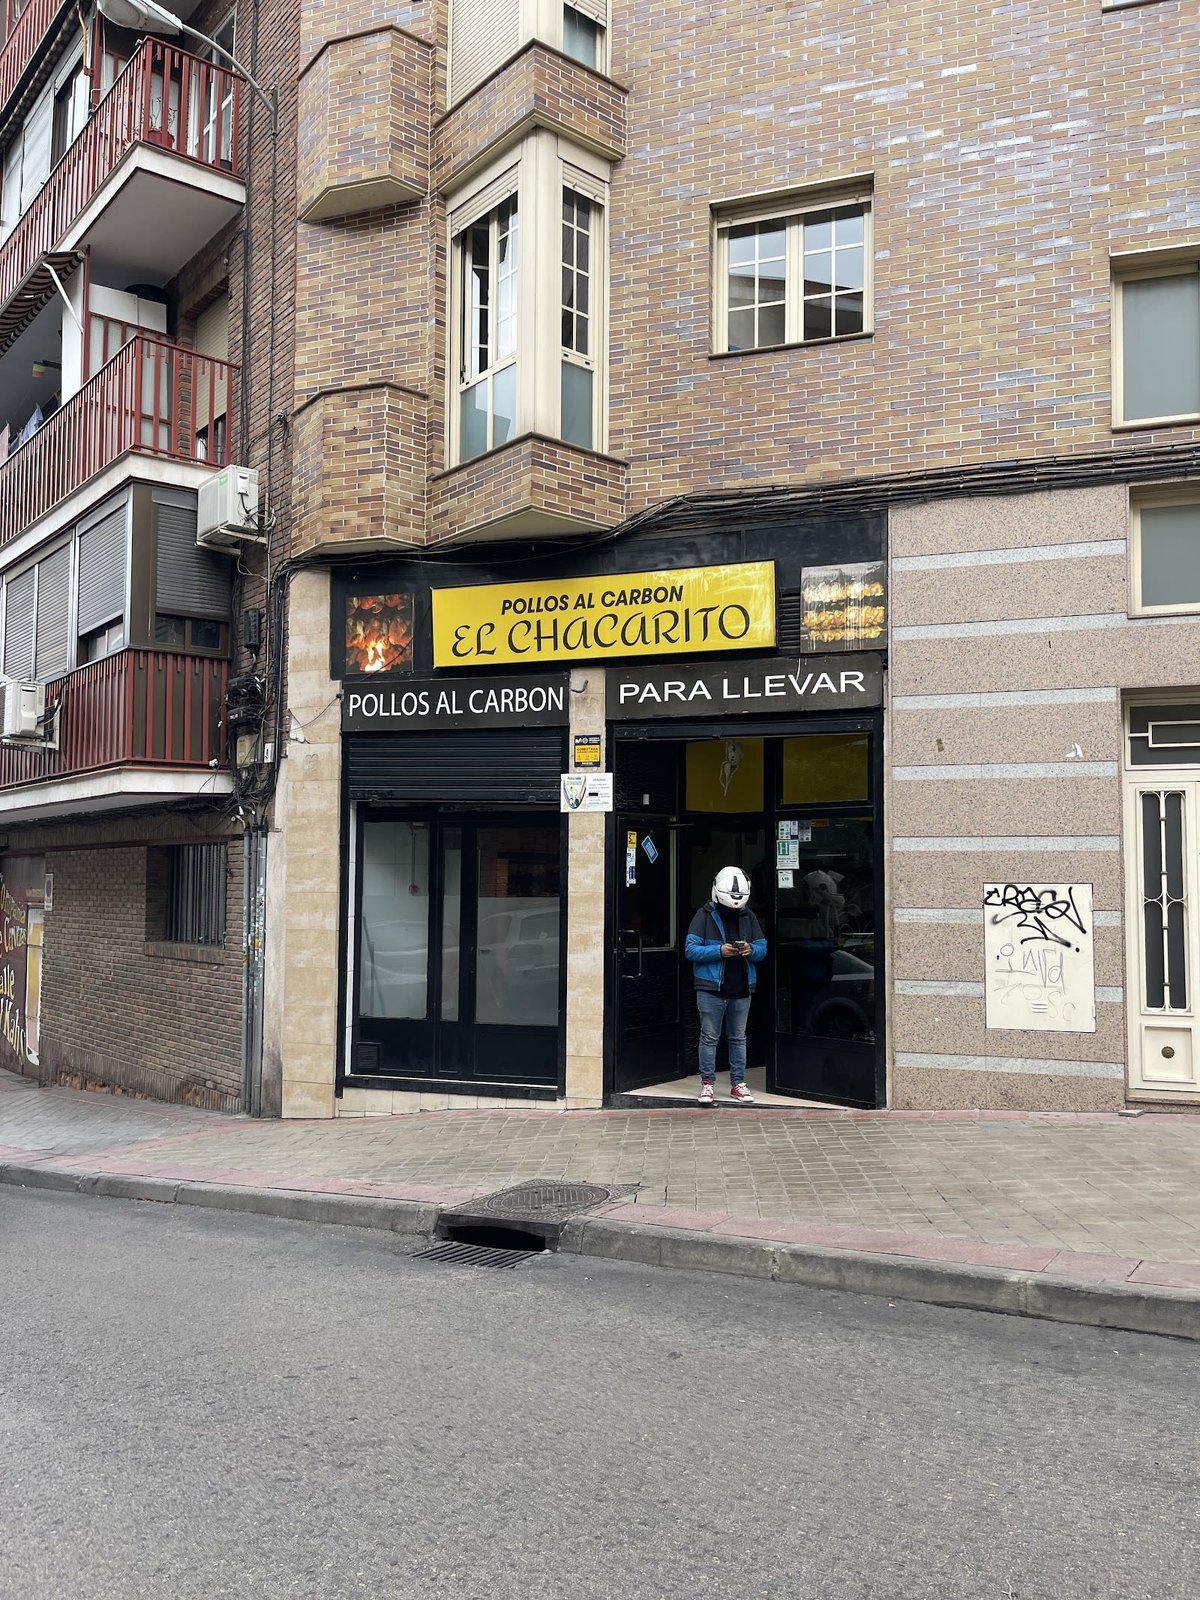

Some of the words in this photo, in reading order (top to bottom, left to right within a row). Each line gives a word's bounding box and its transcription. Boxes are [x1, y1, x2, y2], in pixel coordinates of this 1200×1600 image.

[501, 594, 569, 615] POLLOS
[573, 592, 595, 610] AL
[601, 585, 684, 607] CARBON
[451, 622, 497, 657] EL
[507, 604, 750, 654] CHACARITO
[349, 691, 430, 717] POLLOS
[435, 691, 463, 715] AL
[468, 687, 564, 714] CARBON
[619, 680, 712, 704] PARA
[722, 671, 866, 699] LLEVAR
